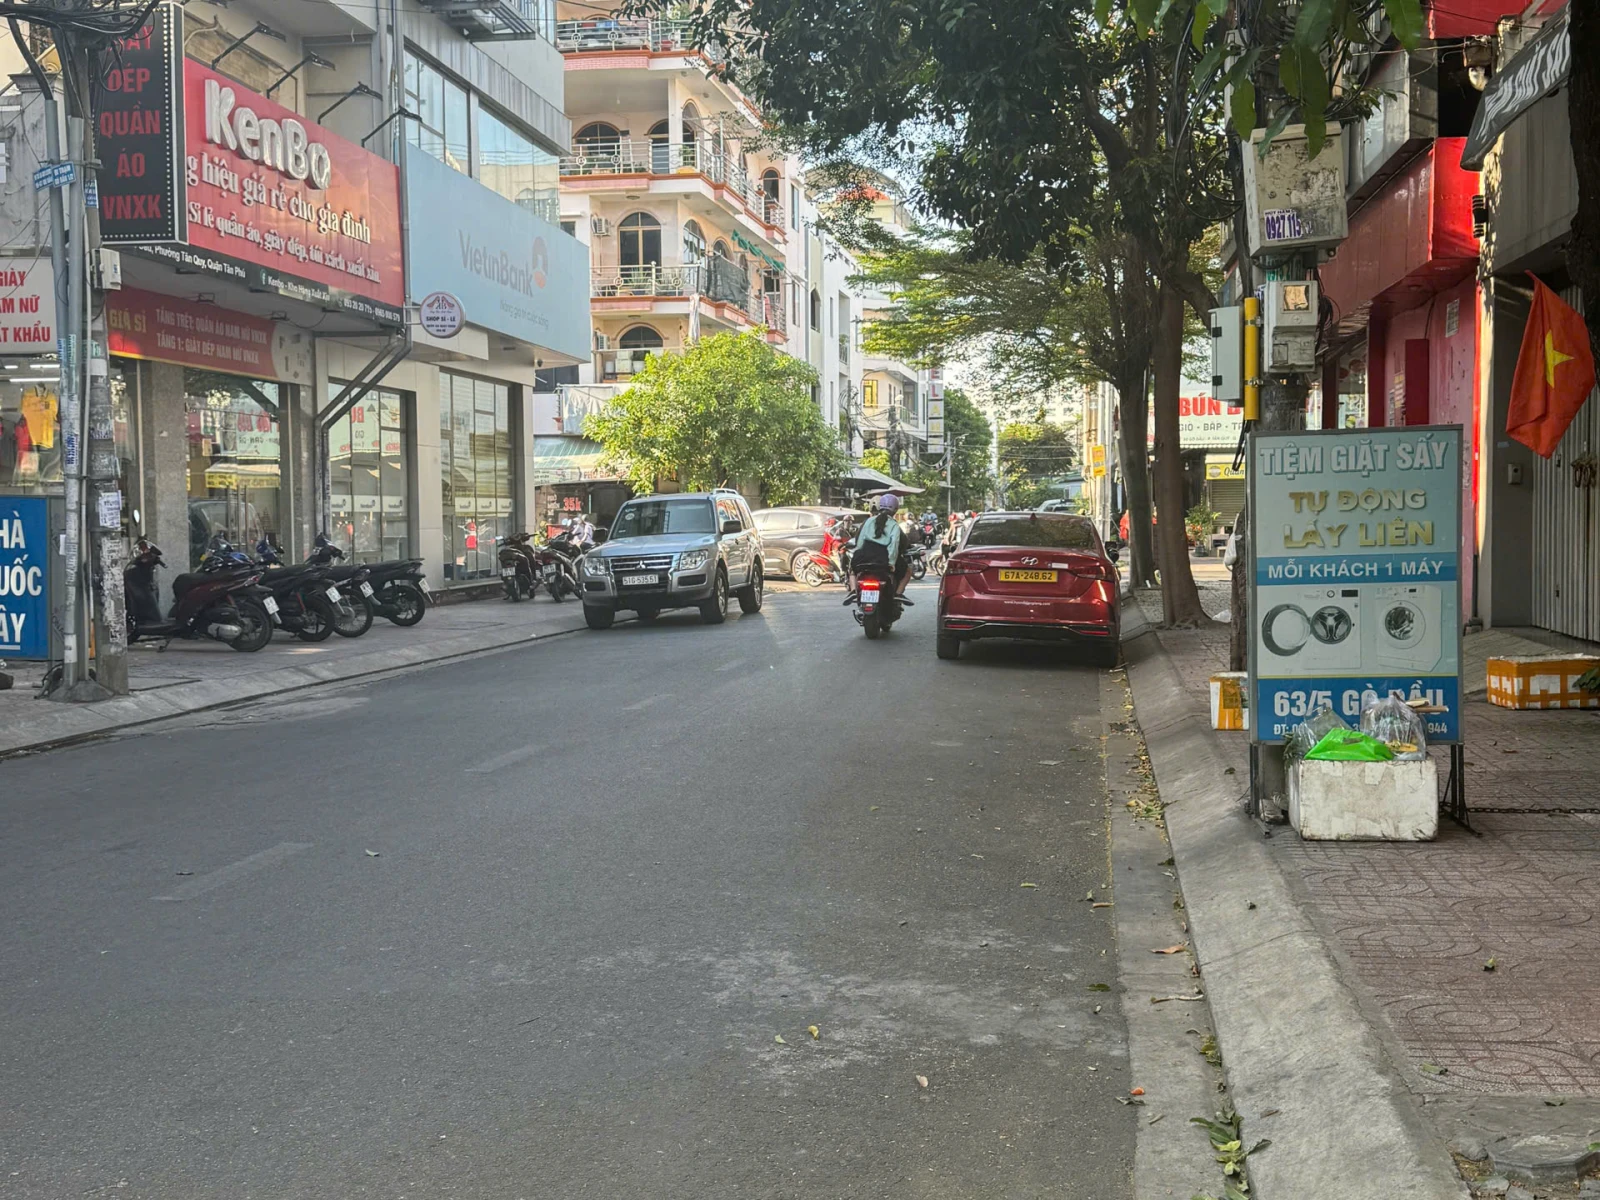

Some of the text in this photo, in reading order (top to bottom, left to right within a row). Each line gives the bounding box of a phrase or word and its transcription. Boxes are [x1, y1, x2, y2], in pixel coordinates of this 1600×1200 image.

[100, 101, 160, 139] QUẦN
[204, 79, 331, 190] KenBo
[116, 148, 145, 178] ÁO
[102, 194, 162, 220] VNXK
[201, 152, 240, 199] hiệu
[241, 172, 267, 207] giá
[269, 182, 287, 212] rẻ
[289, 191, 315, 223] cho
[317, 202, 340, 234] gia
[341, 209, 371, 244] đình
[215, 211, 246, 238] quần
[459, 228, 534, 298] VietinBank
[19, 295, 41, 313] NỮ
[13, 321, 51, 342] KHẨU
[1179, 392, 1221, 416] BÚN
[1260, 433, 1448, 480] TIỆM GIẶT SẤY
[563, 497, 581, 511] 35k
[1288, 487, 1427, 515] TỰ ĐỘNG
[1004, 571, 1053, 580] 67A-248.62
[1268, 557, 1444, 579] MỖI KHÁCH 1 MÁY
[1273, 690, 1333, 717] 63/5
